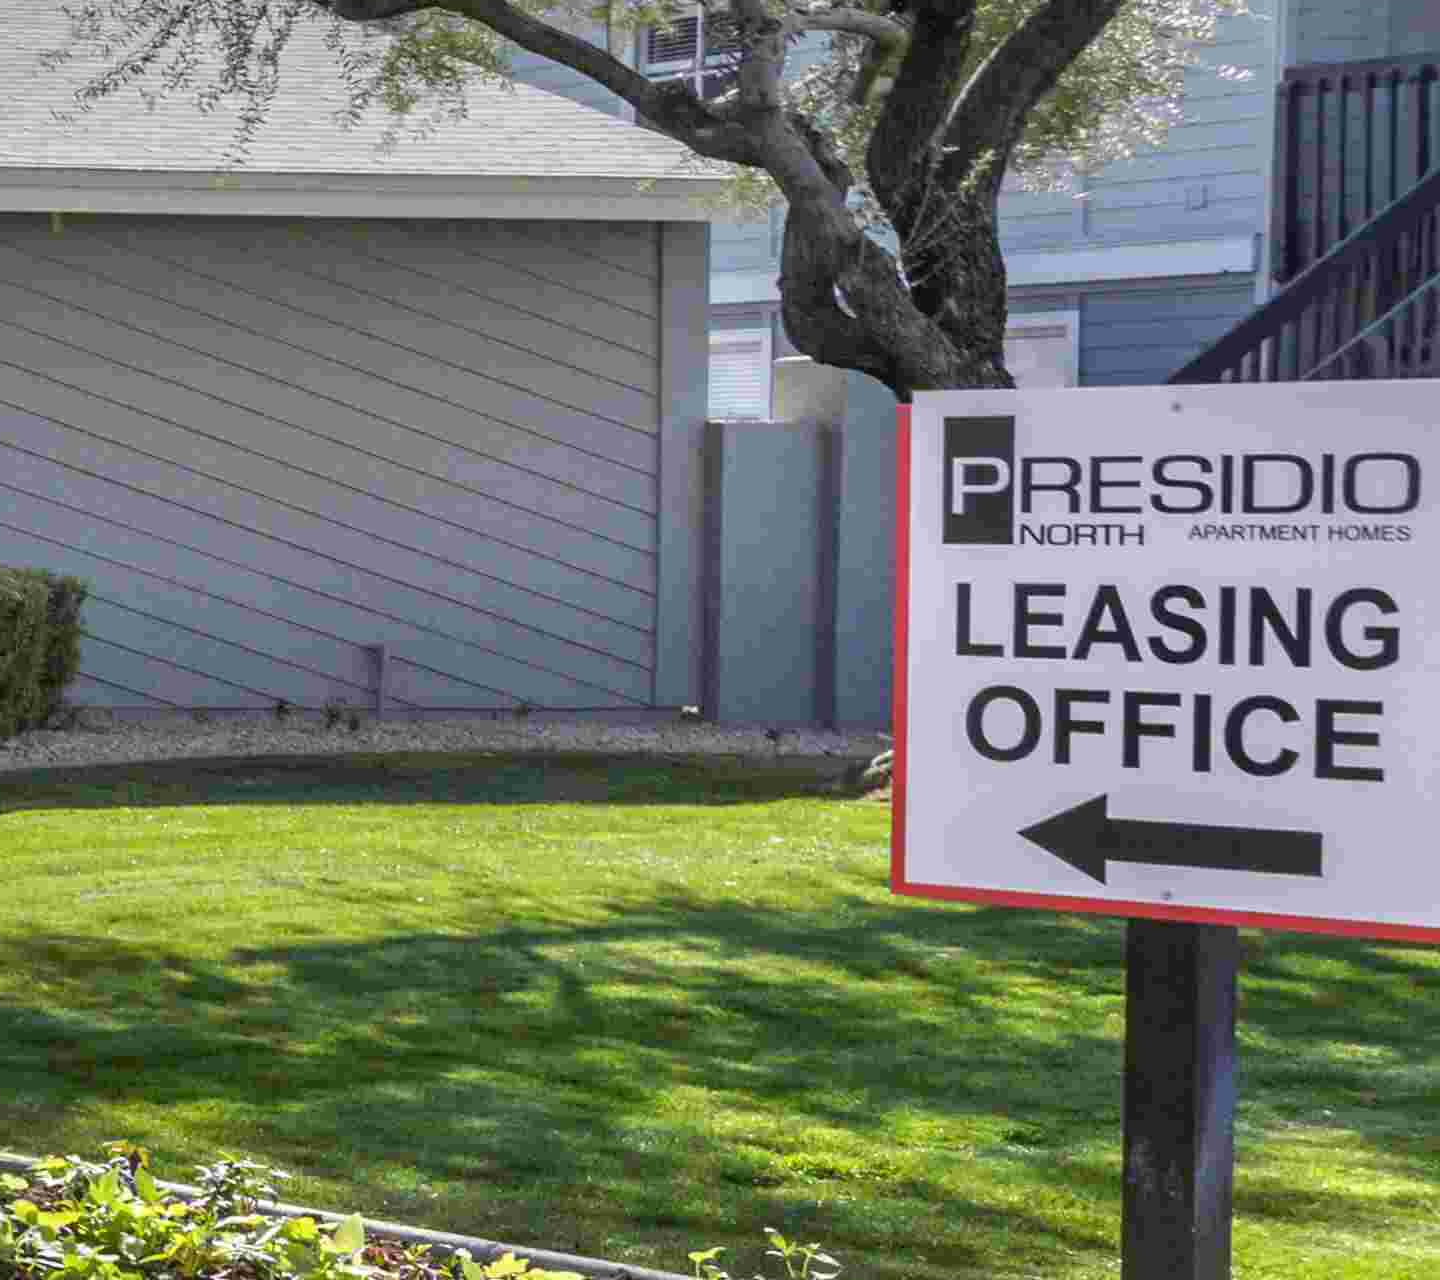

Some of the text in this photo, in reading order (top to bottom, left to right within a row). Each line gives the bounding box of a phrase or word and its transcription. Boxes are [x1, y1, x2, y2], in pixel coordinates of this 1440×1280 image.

[950, 452, 1422, 516] PRESIDIO
[1020, 523, 1413, 547] NORTH APARTMENT HOMES
[955, 582, 1401, 672] LEASING
[964, 685, 1385, 783] OFFICE
